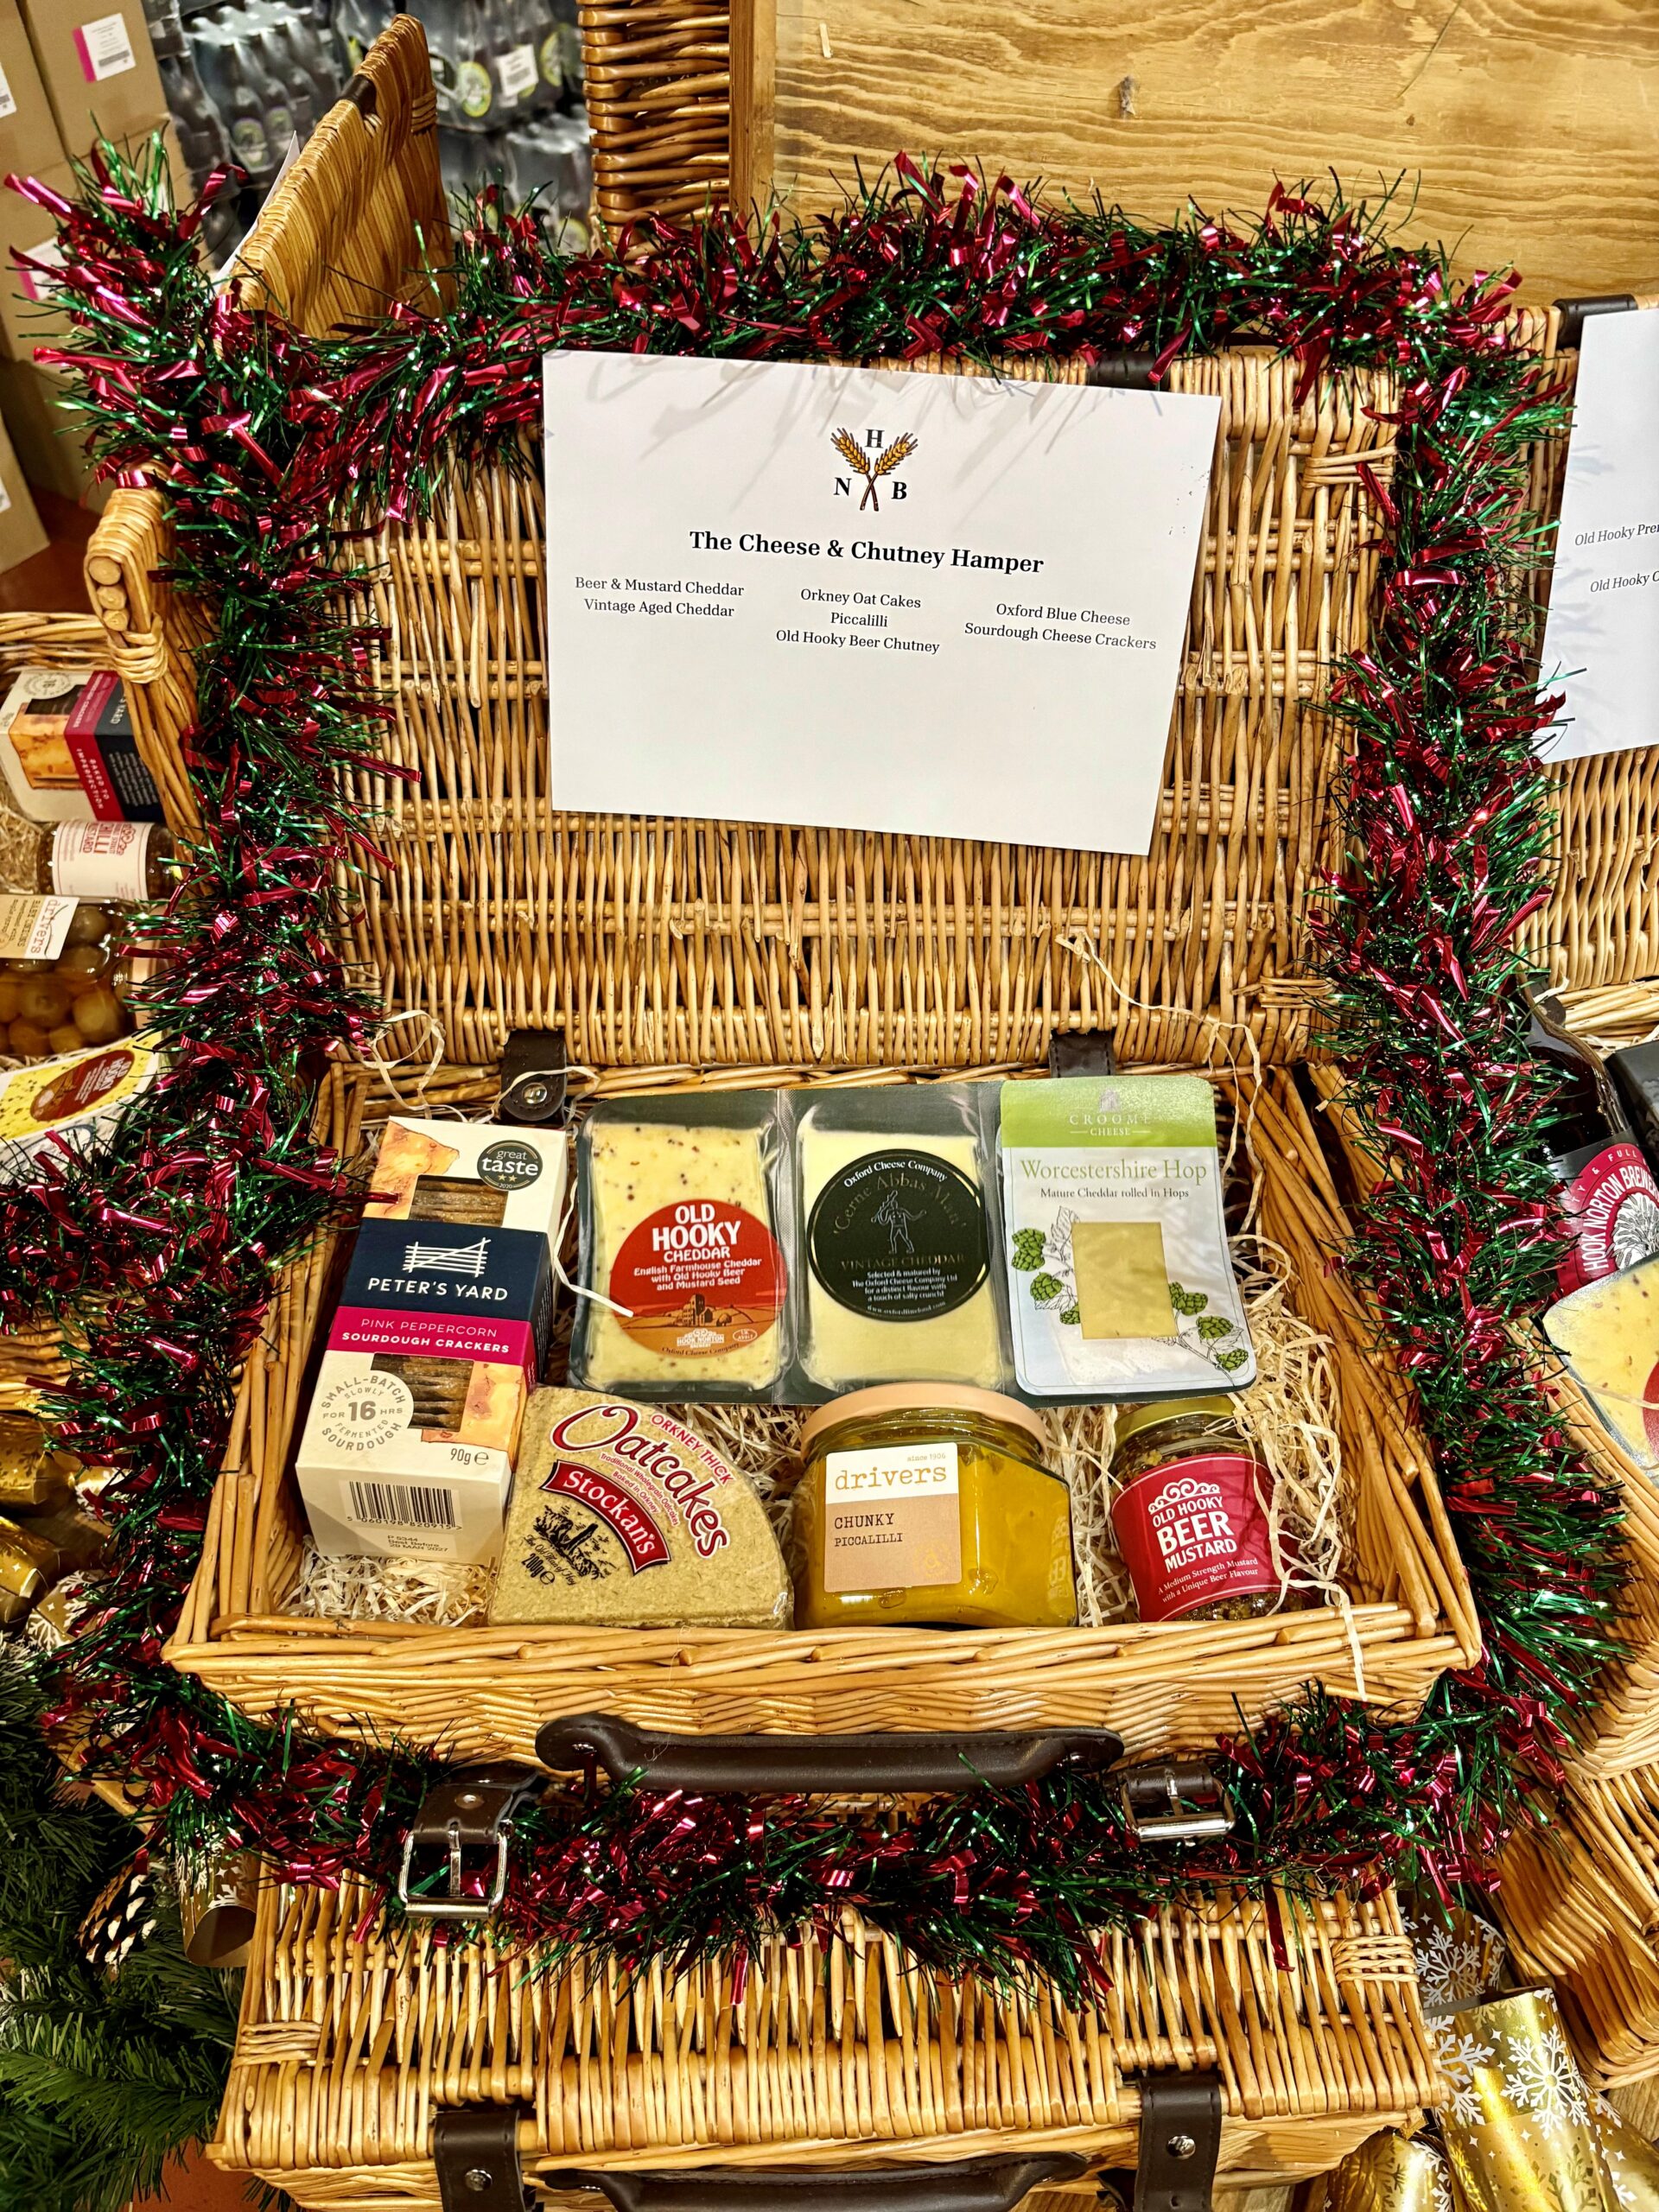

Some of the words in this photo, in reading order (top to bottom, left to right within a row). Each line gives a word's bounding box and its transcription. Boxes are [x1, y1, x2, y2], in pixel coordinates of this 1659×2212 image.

[864, 429, 886, 449] H
[833, 477, 853, 497] N
[890, 480, 908, 500] B
[1574, 531, 1595, 546] Old
[1597, 526, 1636, 543] Hooky
[1637, 524, 1659, 537] Pre
[689, 531, 732, 551] The
[739, 533, 821, 556] Cheese
[827, 539, 844, 558] &
[851, 541, 946, 569] Chutney
[950, 548, 1045, 575] Hamper
[575, 576, 607, 589] Beer
[611, 578, 621, 590] &
[625, 578, 682, 593] Mustard
[685, 581, 745, 596] Cheddar
[1590, 578, 1611, 593] Old
[1611, 573, 1650, 589] Hooky
[584, 598, 636, 614] Vintage
[639, 601, 672, 616] Aged
[676, 602, 734, 617] Cheddar
[800, 588, 850, 606] Orkney
[853, 592, 877, 606] Oat
[880, 594, 921, 608] Cakes
[830, 612, 888, 627] Piccalilli
[996, 603, 1044, 619] Oxford
[1046, 607, 1077, 621] Blue
[1080, 610, 1130, 626] Cheese
[776, 629, 799, 643] Old
[803, 631, 847, 648] Hooky
[849, 634, 880, 648] Beer
[883, 637, 940, 655] Chutney
[964, 622, 1039, 642] Sourdough
[1042, 628, 1092, 644] Cheese
[1095, 633, 1157, 650] Crackers
[1090, 1127, 1131, 1136] CHEESE
[496, 1150, 527, 1160] great
[1592, 1166, 1599, 1175] &
[1607, 1148, 1637, 1162] FULL
[481, 1157, 538, 1176] taste
[843, 1165, 873, 1187] Oxford
[873, 1160, 906, 1172] Cheese
[907, 1160, 948, 1182] Company
[1020, 1159, 1157, 1179] Worcestershire
[1163, 1159, 1207, 1185] Hop
[1039, 1187, 1075, 1198] Mature
[1077, 1186, 1118, 1198] Cheddar
[1121, 1186, 1148, 1198] rolled
[1151, 1187, 1160, 1198] in
[1162, 1187, 1189, 1201] Hops
[1583, 1172, 1625, 1230] NORTON
[674, 1203, 715, 1224] OLD
[652, 1220, 741, 1251] HOOKY
[663, 1245, 731, 1263] CHEDDAR
[1580, 1231, 1609, 1272] HOOK
[633, 1264, 667, 1276] English
[670, 1261, 721, 1274] Farmhouse
[723, 1258, 762, 1268] Cheddar
[651, 1273, 671, 1283] with
[673, 1271, 689, 1281] Old
[691, 1270, 721, 1280] Hooky
[722, 1268, 745, 1276] Beer
[867, 1269, 894, 1278] Selected
[903, 1268, 931, 1276] matured
[932, 1267, 941, 1275] by
[656, 1281, 673, 1291] and
[676, 1278, 715, 1289] Mustard
[717, 1275, 741, 1285] Seed
[864, 1286, 874, 1294] for
[880, 1284, 906, 1294] distinct
[906, 1283, 929, 1292] flavour
[865, 1277, 888, 1287] Oxford
[889, 1276, 912, 1285] Cheese
[914, 1274, 945, 1284] Company
[454, 1284, 508, 1300] YARD
[874, 1293, 893, 1301] touch
[902, 1291, 918, 1300] salty
[360, 1318, 394, 1330] PINK
[400, 1321, 498, 1338] PEPPERCORN
[341, 1332, 430, 1346] SOURDOUGH
[435, 1338, 510, 1353] CRACKERS
[321, 1375, 406, 1408] SMALL-BATCH
[344, 1386, 385, 1399] SLOWLY
[347, 1400, 376, 1421] 16
[321, 1422, 402, 1451] SOURDOUGH
[334, 1419, 388, 1438] FERMENTED
[449, 1447, 471, 1465] 90g
[651, 1413, 703, 1452] ORKNEY
[698, 1448, 735, 1485] THICK
[551, 1405, 728, 1557] Oatcakes
[601, 1452, 635, 1473] Traditional
[633, 1469, 663, 1499] Wholegrain
[661, 1497, 678, 1525] Oatcakes
[835, 1465, 947, 1491] drivers
[612, 1471, 634, 1487] Baked
[639, 1491, 658, 1513] Orkney
[834, 1512, 895, 1529] CHUNKY
[1152, 1508, 1175, 1528] OLD
[1177, 1496, 1224, 1516] HOOKY
[834, 1532, 903, 1548] PICCALILLI
[1156, 1510, 1235, 1556] BEER
[521, 1553, 544, 1578] 200g
[1164, 1538, 1237, 1573] MUSTARD
[562, 1570, 576, 1586] Hoy
[1163, 1573, 1191, 1590] Medium
[1192, 1561, 1225, 1578] Strength
[1226, 1557, 1258, 1568] Mustard
[1162, 1592, 1175, 1603] with
[1181, 1579, 1209, 1592] Unique
[1210, 1573, 1227, 1582] Beer
[1229, 1567, 1258, 1578] Flavour
